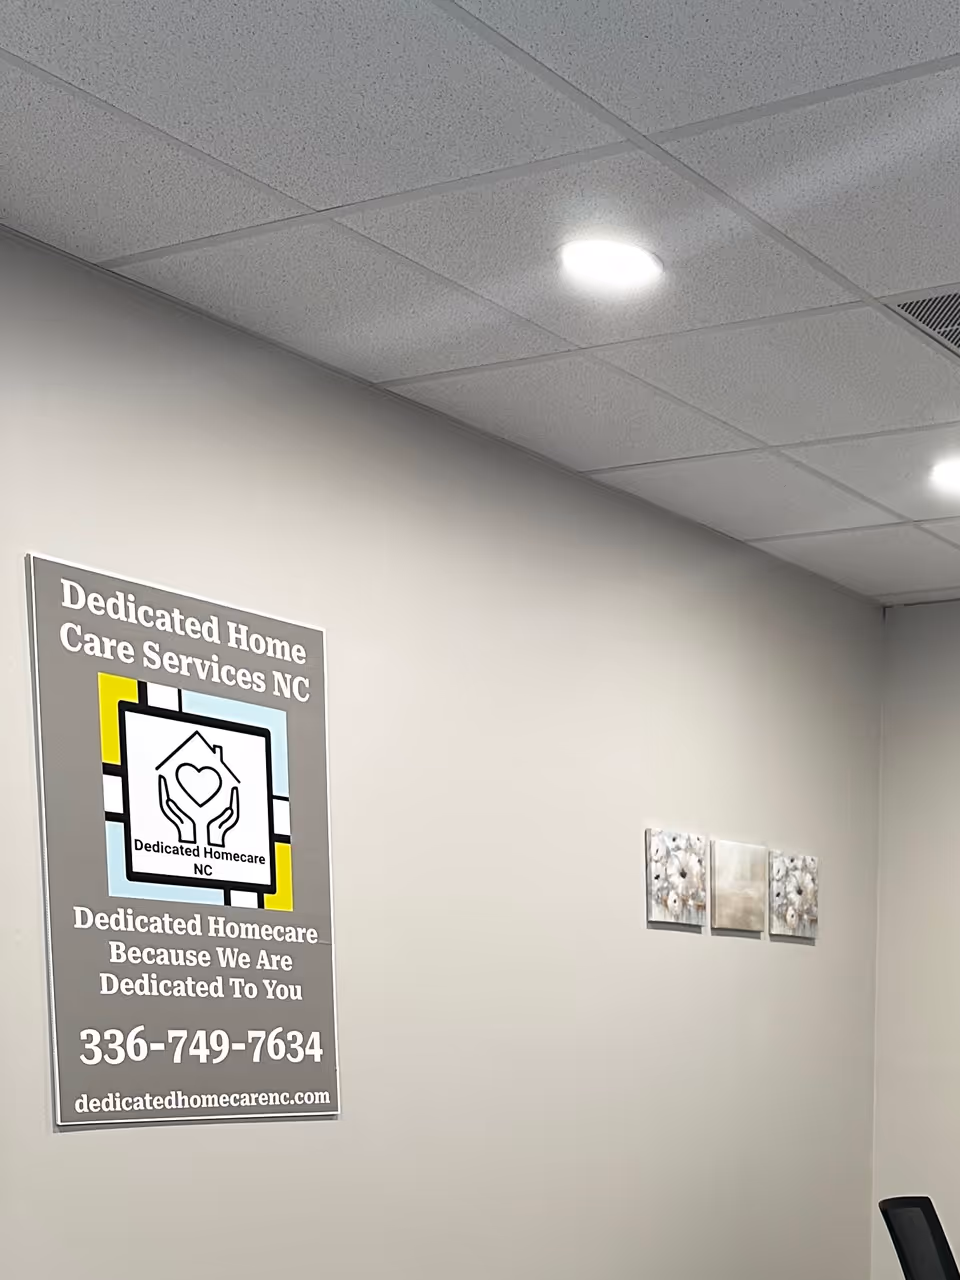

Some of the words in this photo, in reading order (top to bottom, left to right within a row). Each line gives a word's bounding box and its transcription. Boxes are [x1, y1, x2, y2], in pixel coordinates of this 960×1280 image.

[60, 577, 220, 644] Dedicated
[227, 621, 307, 665] Home
[59, 622, 135, 664] Care
[143, 640, 266, 693] Services
[272, 670, 310, 702] NC
[134, 838, 200, 858] Dedicated
[203, 846, 266, 865] Homecare
[193, 863, 213, 876] NC
[73, 905, 203, 936] Dedicated
[207, 916, 319, 944] Homecare
[108, 941, 211, 968] Because
[215, 946, 251, 969] We
[256, 949, 293, 971] Are
[99, 972, 224, 998] Dedicated
[229, 977, 258, 999] To
[262, 979, 303, 1001] You
[79, 1024, 324, 1065] 336-749-7634
[74, 1089, 331, 1114] dedicatedhomecarenc.com
